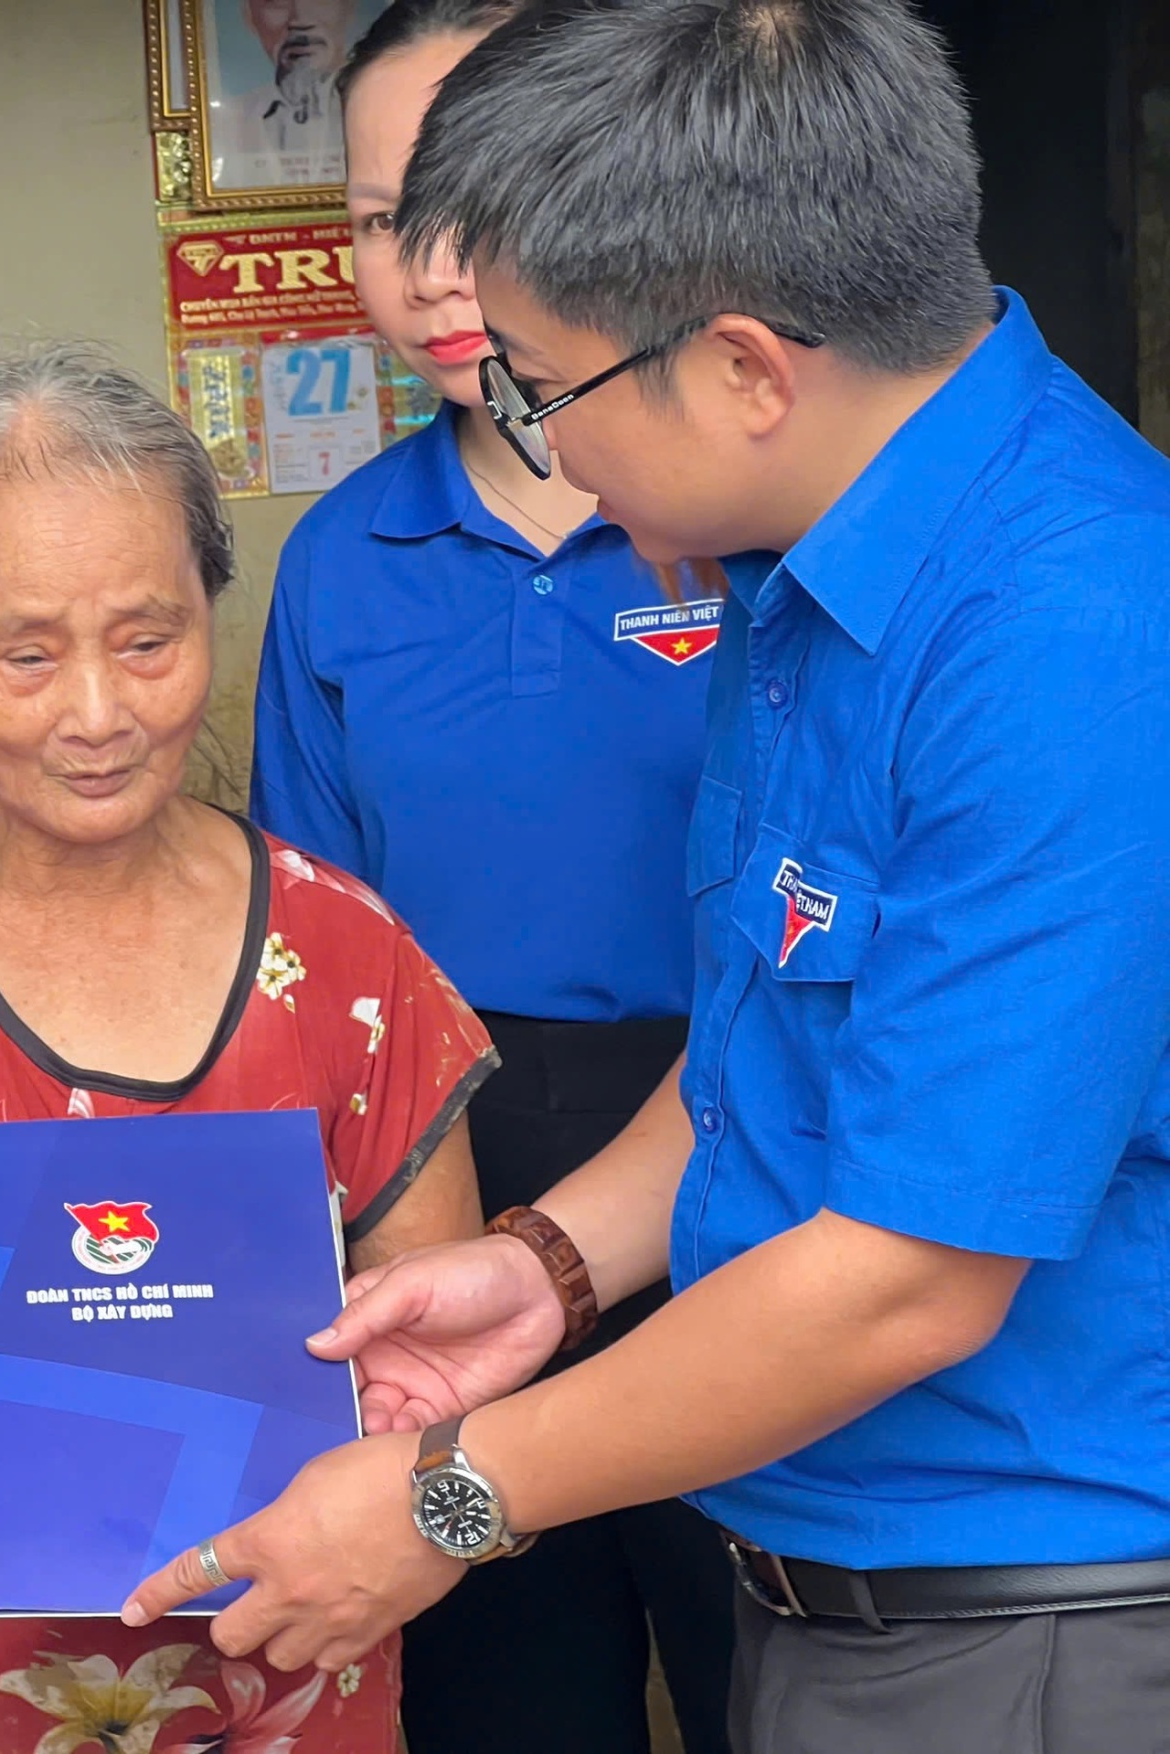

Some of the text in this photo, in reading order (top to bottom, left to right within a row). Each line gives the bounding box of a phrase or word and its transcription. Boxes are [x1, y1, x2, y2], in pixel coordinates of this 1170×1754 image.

[286, 348, 350, 416] 27
[318, 452, 330, 476] 7
[620, 605, 719, 630] THANH NIÊN VIỆT
[26, 1282, 214, 1304] ĐOÀN TNCS HỒ CHÍ MINH
[71, 1302, 173, 1323] BỘ XÂY DỰNG
